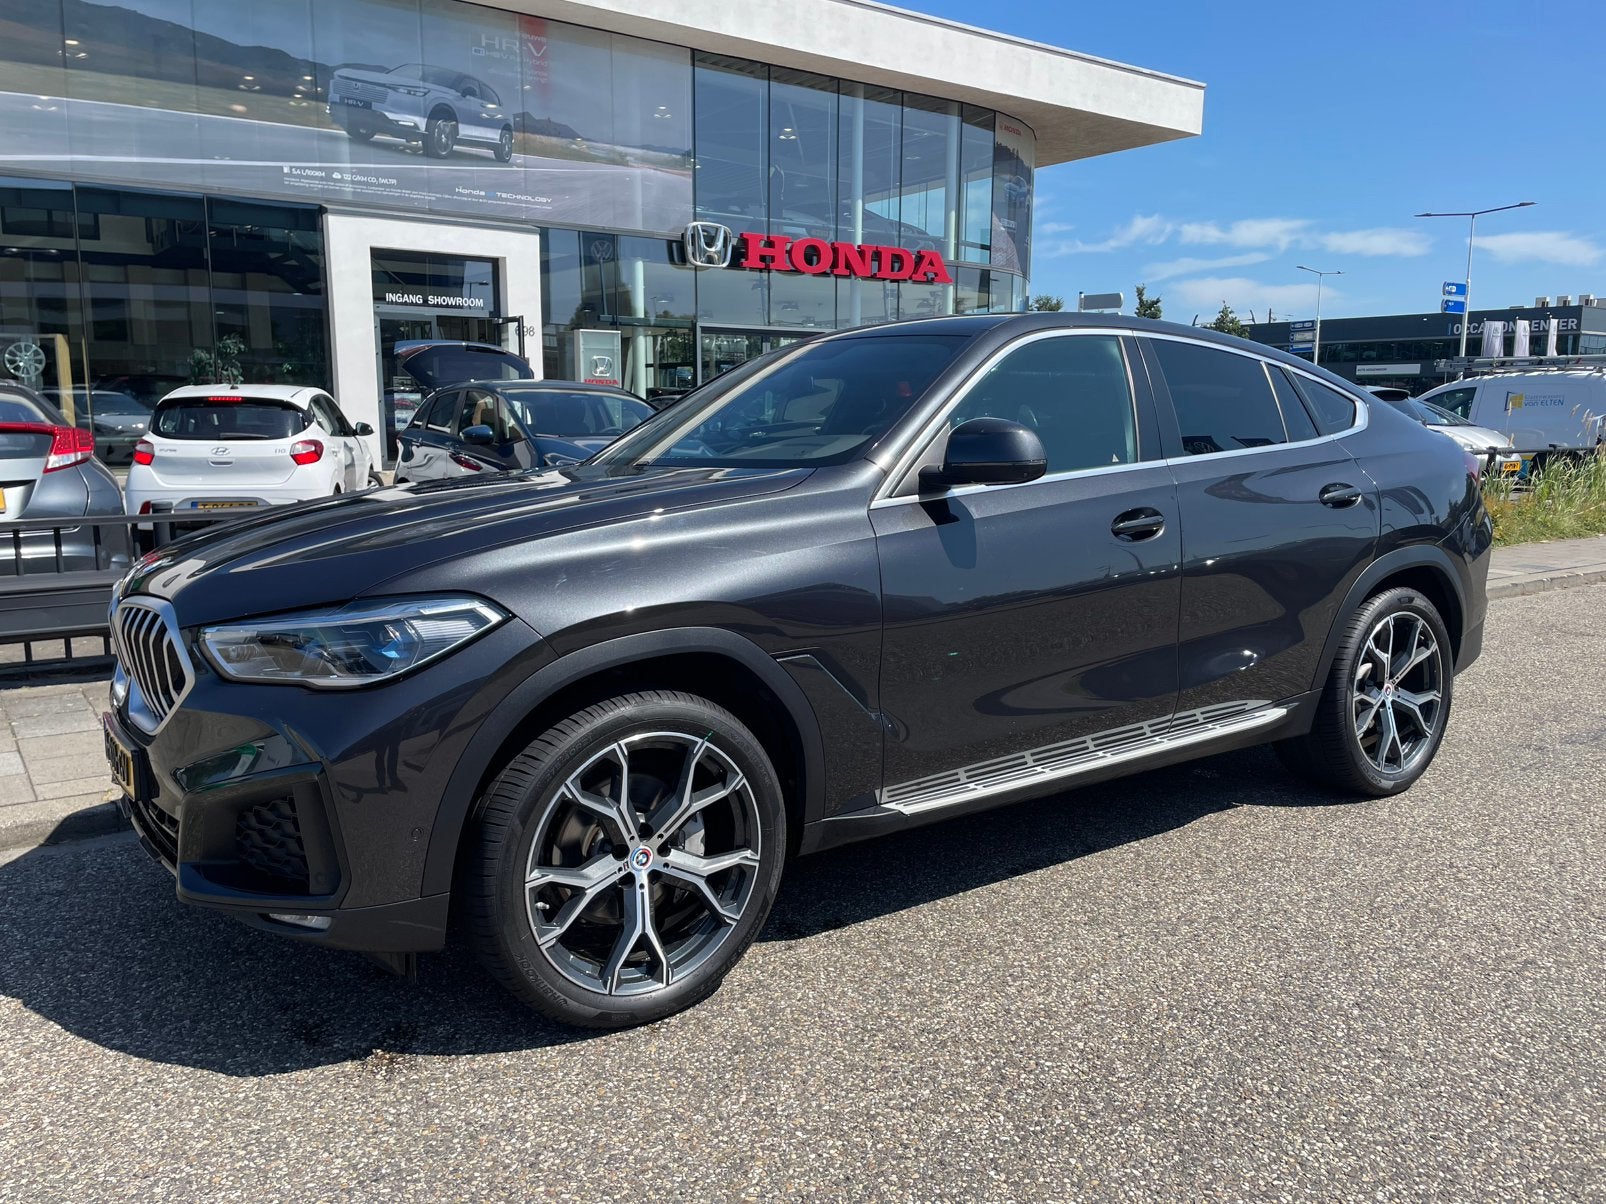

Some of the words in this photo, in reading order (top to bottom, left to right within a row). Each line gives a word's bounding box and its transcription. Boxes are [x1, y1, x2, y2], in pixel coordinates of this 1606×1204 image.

[481, 33, 547, 57] HR-V
[455, 186, 486, 196] Honda
[740, 232, 953, 284] HONDA
[385, 292, 423, 304] INGANG
[427, 295, 484, 307] SHOWROOM
[1525, 318, 1578, 332] ENER
[1540, 399, 1565, 407] ELTEN
